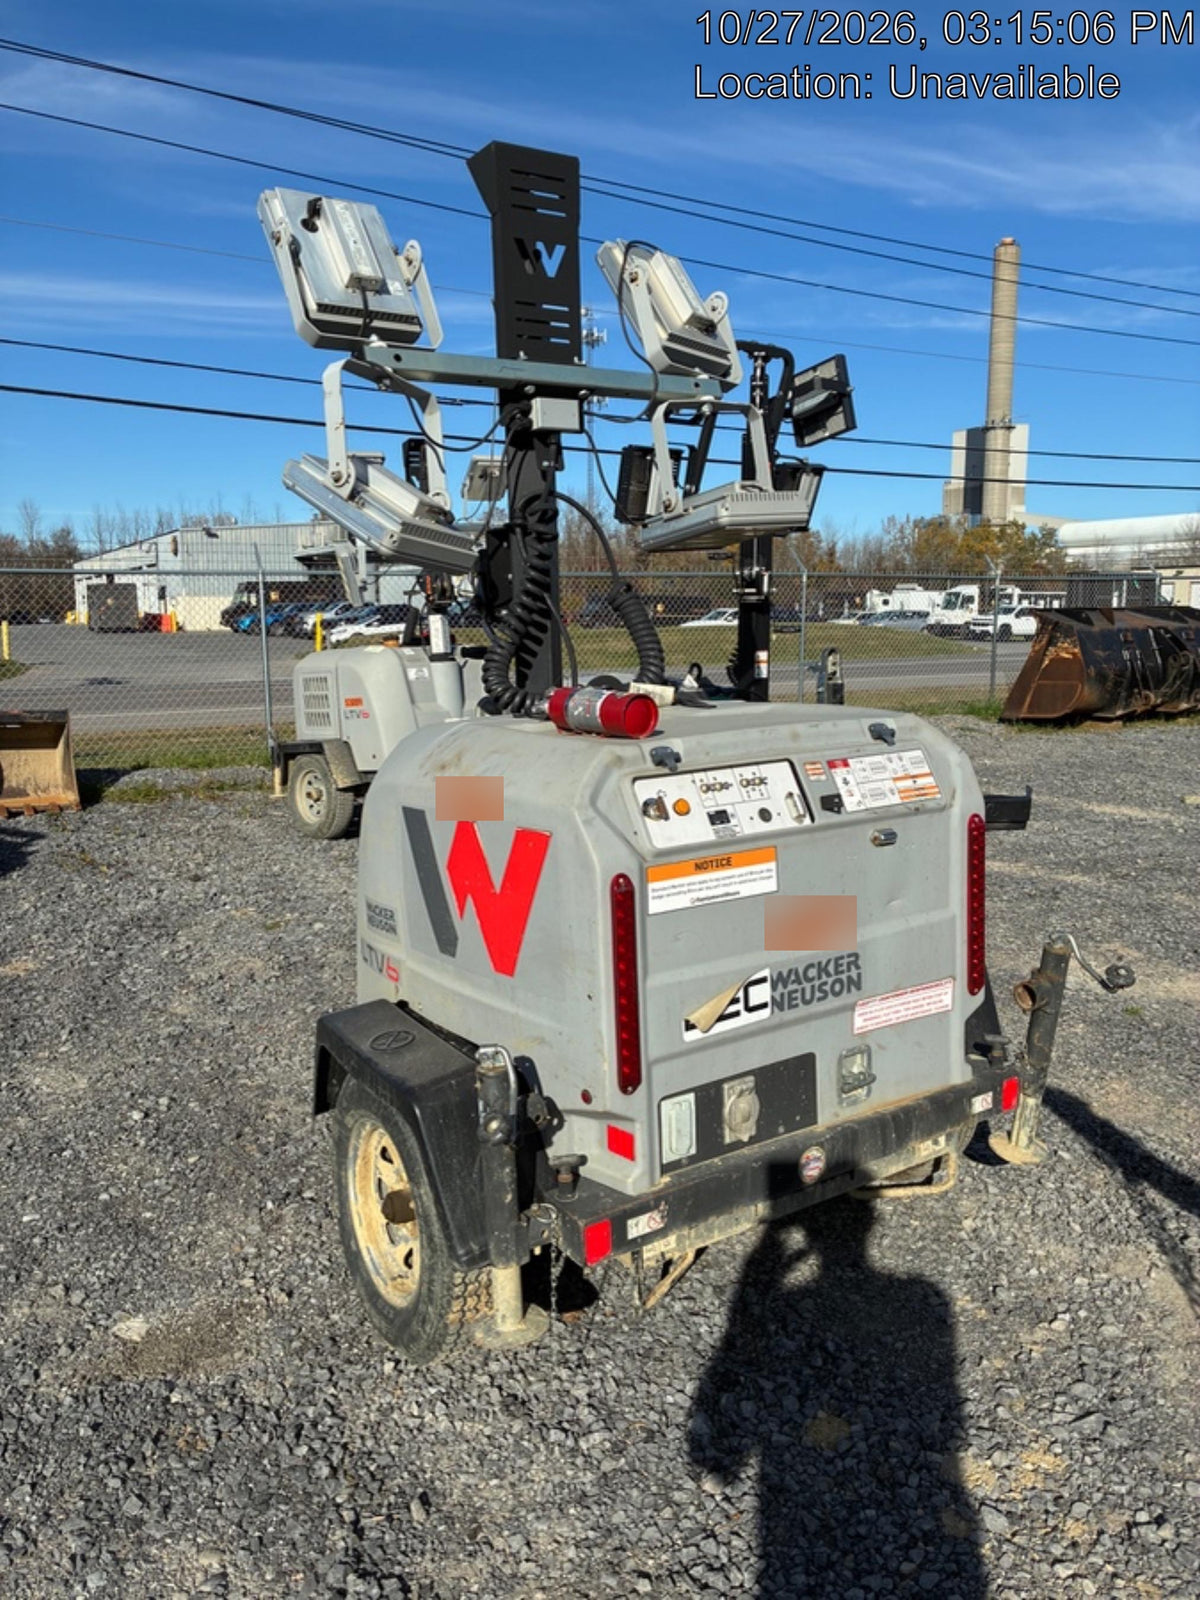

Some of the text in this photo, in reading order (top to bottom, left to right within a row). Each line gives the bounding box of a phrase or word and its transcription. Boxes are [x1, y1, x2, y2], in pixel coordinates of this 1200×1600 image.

[694, 856, 733, 872] NOTICE
[772, 952, 861, 992] WACKER
[772, 972, 862, 1015] NEUSON
